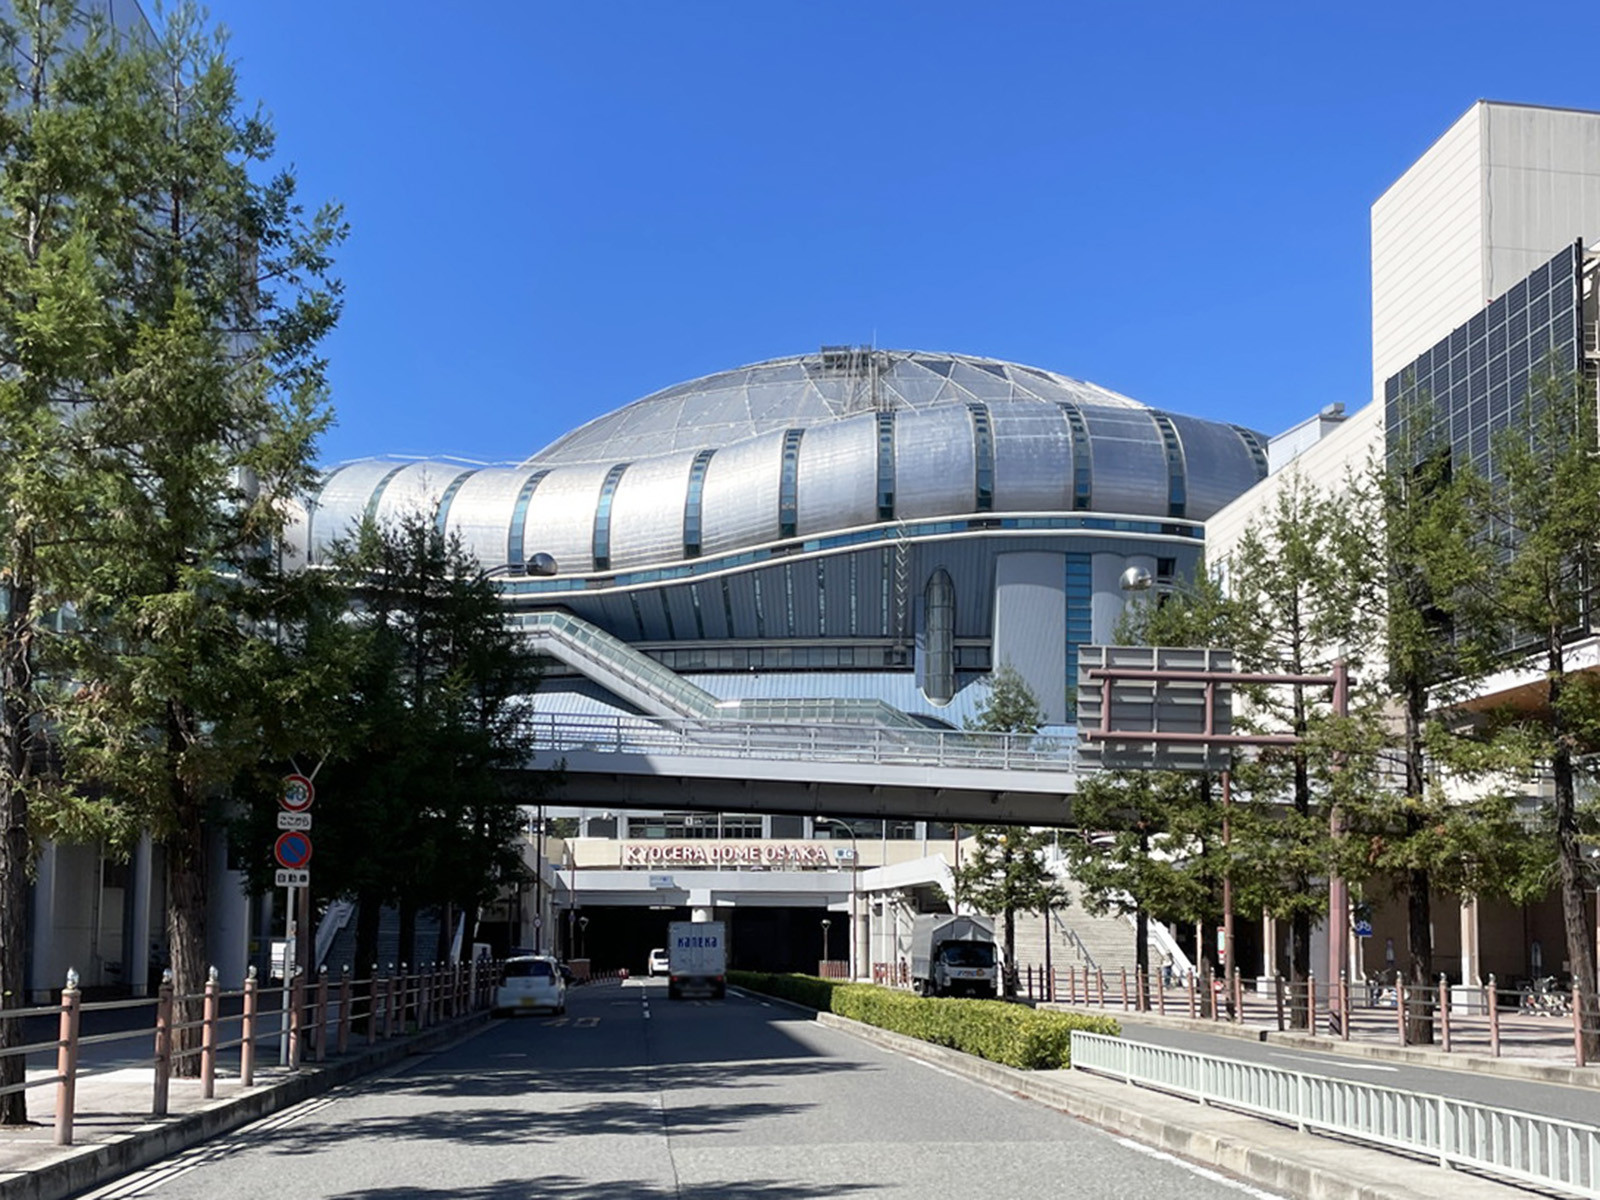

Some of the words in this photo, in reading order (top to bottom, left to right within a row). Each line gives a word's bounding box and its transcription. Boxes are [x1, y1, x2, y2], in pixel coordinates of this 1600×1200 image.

[279, 816, 310, 827] ここから
[626, 845, 706, 861] KYOCERA
[710, 845, 760, 861] DOME
[764, 845, 828, 861] OSAKA
